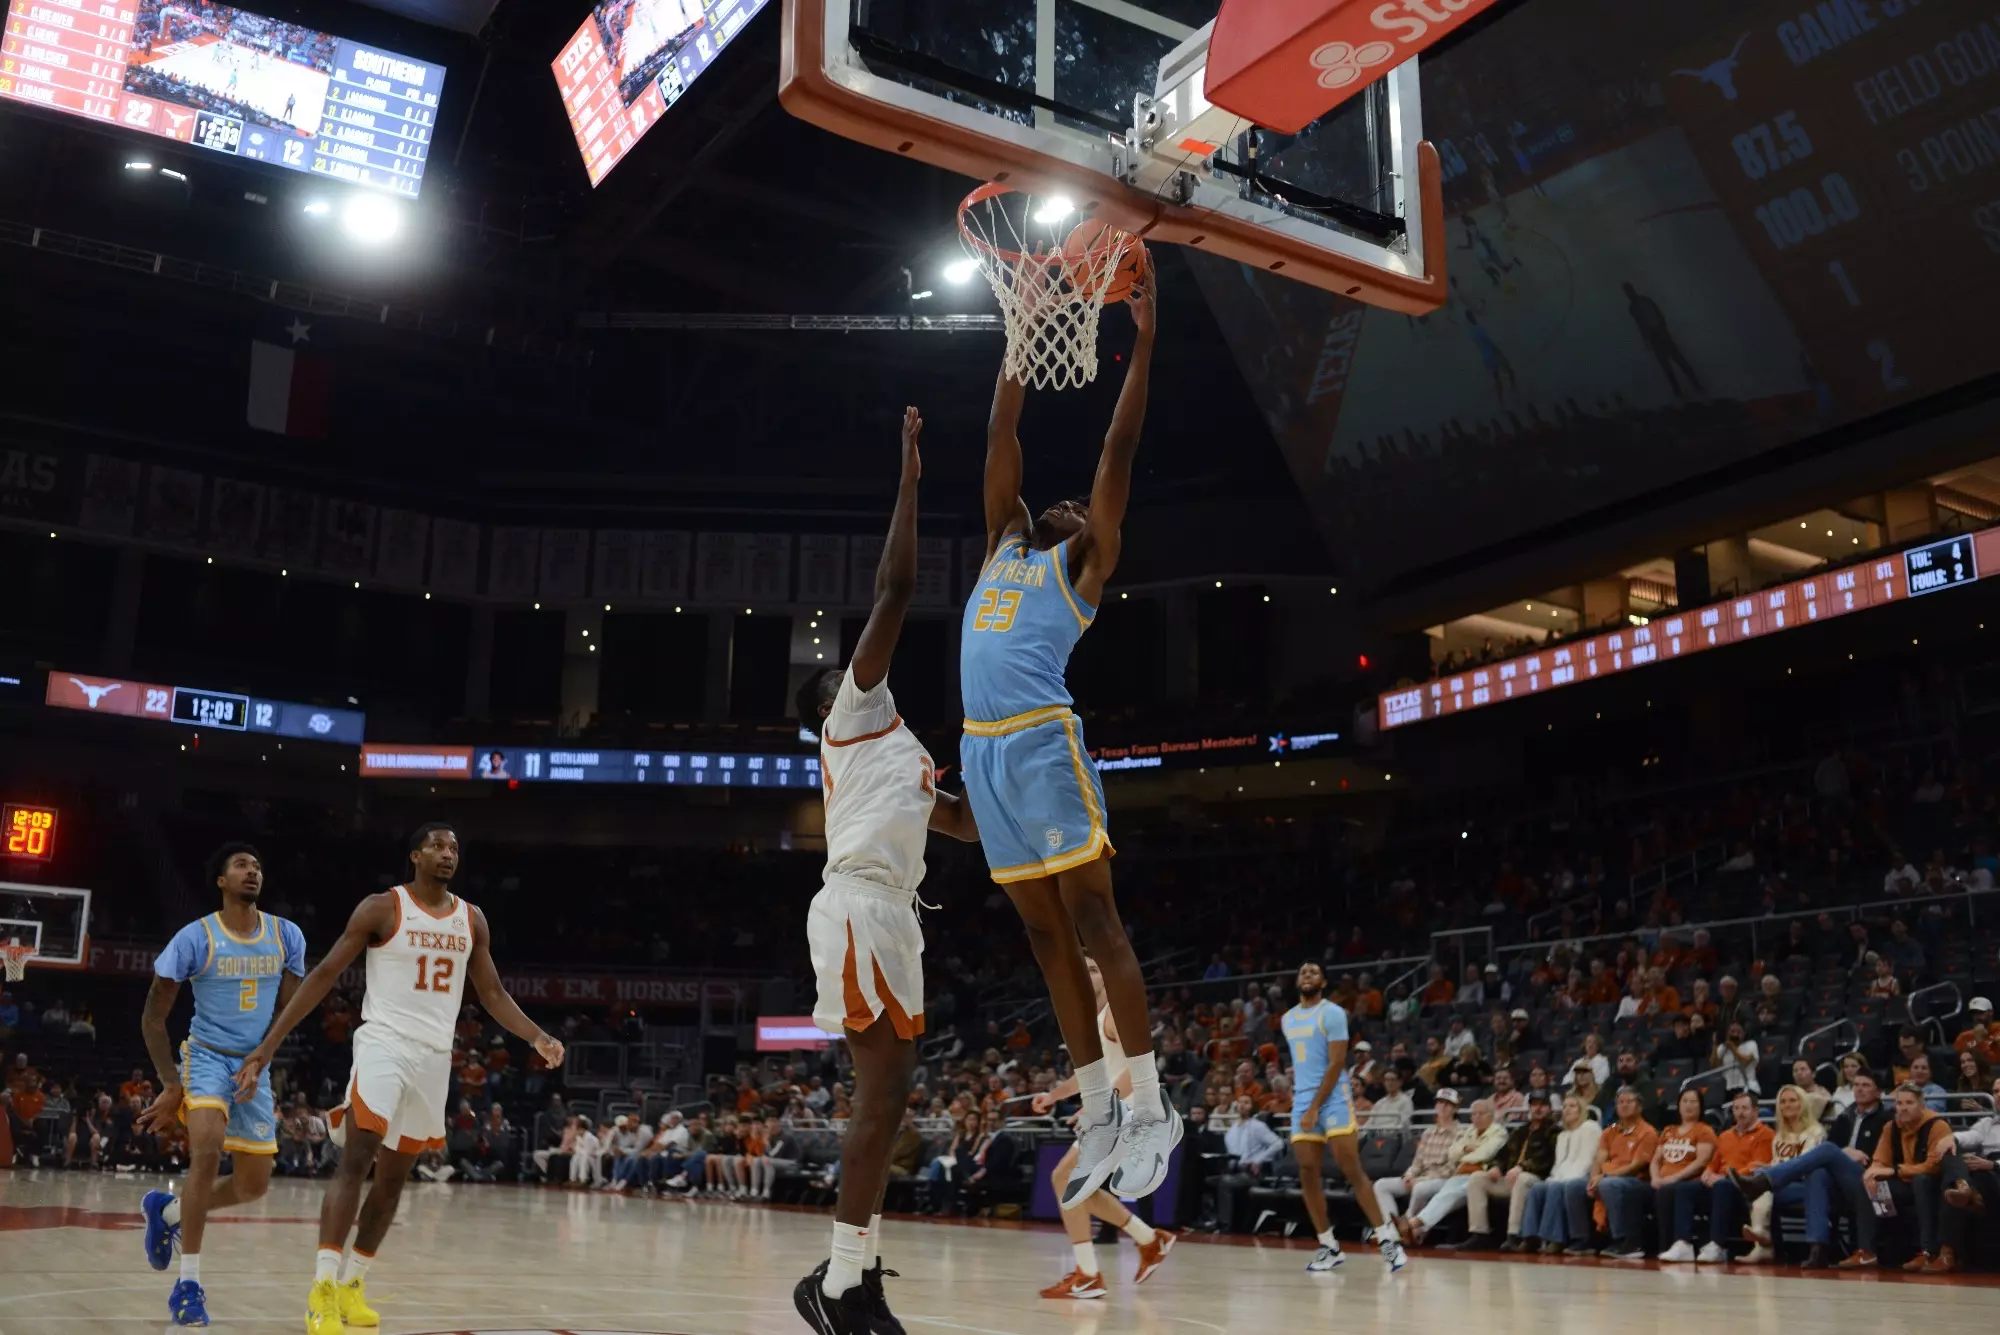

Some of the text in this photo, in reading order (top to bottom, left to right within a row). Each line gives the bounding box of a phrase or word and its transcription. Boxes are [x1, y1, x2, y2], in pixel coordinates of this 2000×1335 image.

[1776, 0, 1877, 66] GAME
[353, 49, 426, 86] SOUTHERN
[1853, 14, 2000, 125] FIELD GOA
[124, 99, 153, 127] 22
[199, 120, 239, 145] 12:03
[1731, 109, 1813, 181] 87.5
[283, 139, 304, 165] 12
[1896, 148, 1929, 192] 3
[1754, 172, 1860, 250] 100.0
[1828, 260, 1861, 308] 1
[1865, 341, 1910, 391] 2
[1911, 563, 1964, 591] FOULS: 2
[972, 588, 1024, 633] 23
[145, 689, 169, 713] 22
[192, 697, 234, 721] 12:03
[255, 703, 273, 727] 12
[1385, 689, 1421, 713] TEXAS
[1100, 747, 1129, 758] Texas
[1131, 744, 1159, 756] Farm
[1161, 741, 1199, 753] Bureau
[1202, 735, 1258, 749] Members!
[525, 753, 541, 778] 11
[634, 754, 650, 767] PTS
[748, 757, 764, 770] AST
[14, 810, 52, 828] 12:03
[9, 825, 44, 855] 20
[406, 930, 467, 952] TEXAS
[216, 955, 280, 977] SOUTHERN
[413, 955, 455, 993] 12
[239, 978, 258, 1011] 2
[503, 977, 548, 997] OOK
[616, 980, 699, 1001] HORNS
